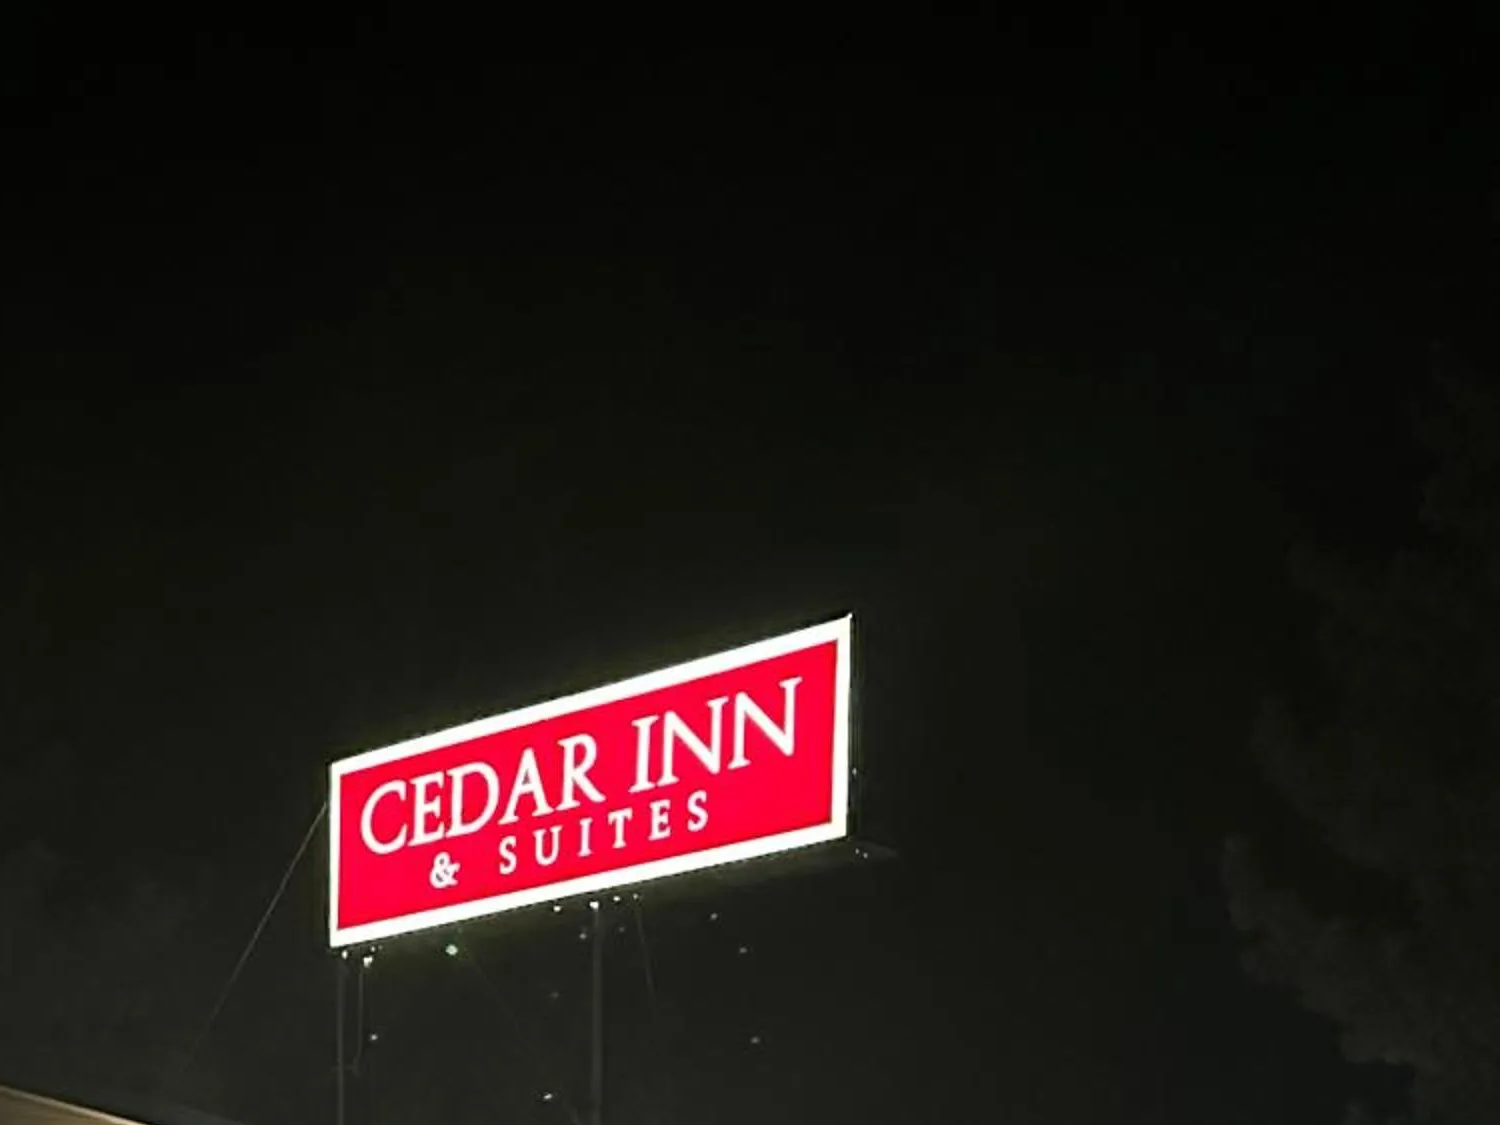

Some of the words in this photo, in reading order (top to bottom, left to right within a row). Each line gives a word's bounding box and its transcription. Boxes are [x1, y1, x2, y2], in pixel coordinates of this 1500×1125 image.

[360, 733, 606, 855] CEDAR
[629, 676, 802, 793] INN
[429, 851, 461, 889] &
[499, 790, 709, 875] SUITES
